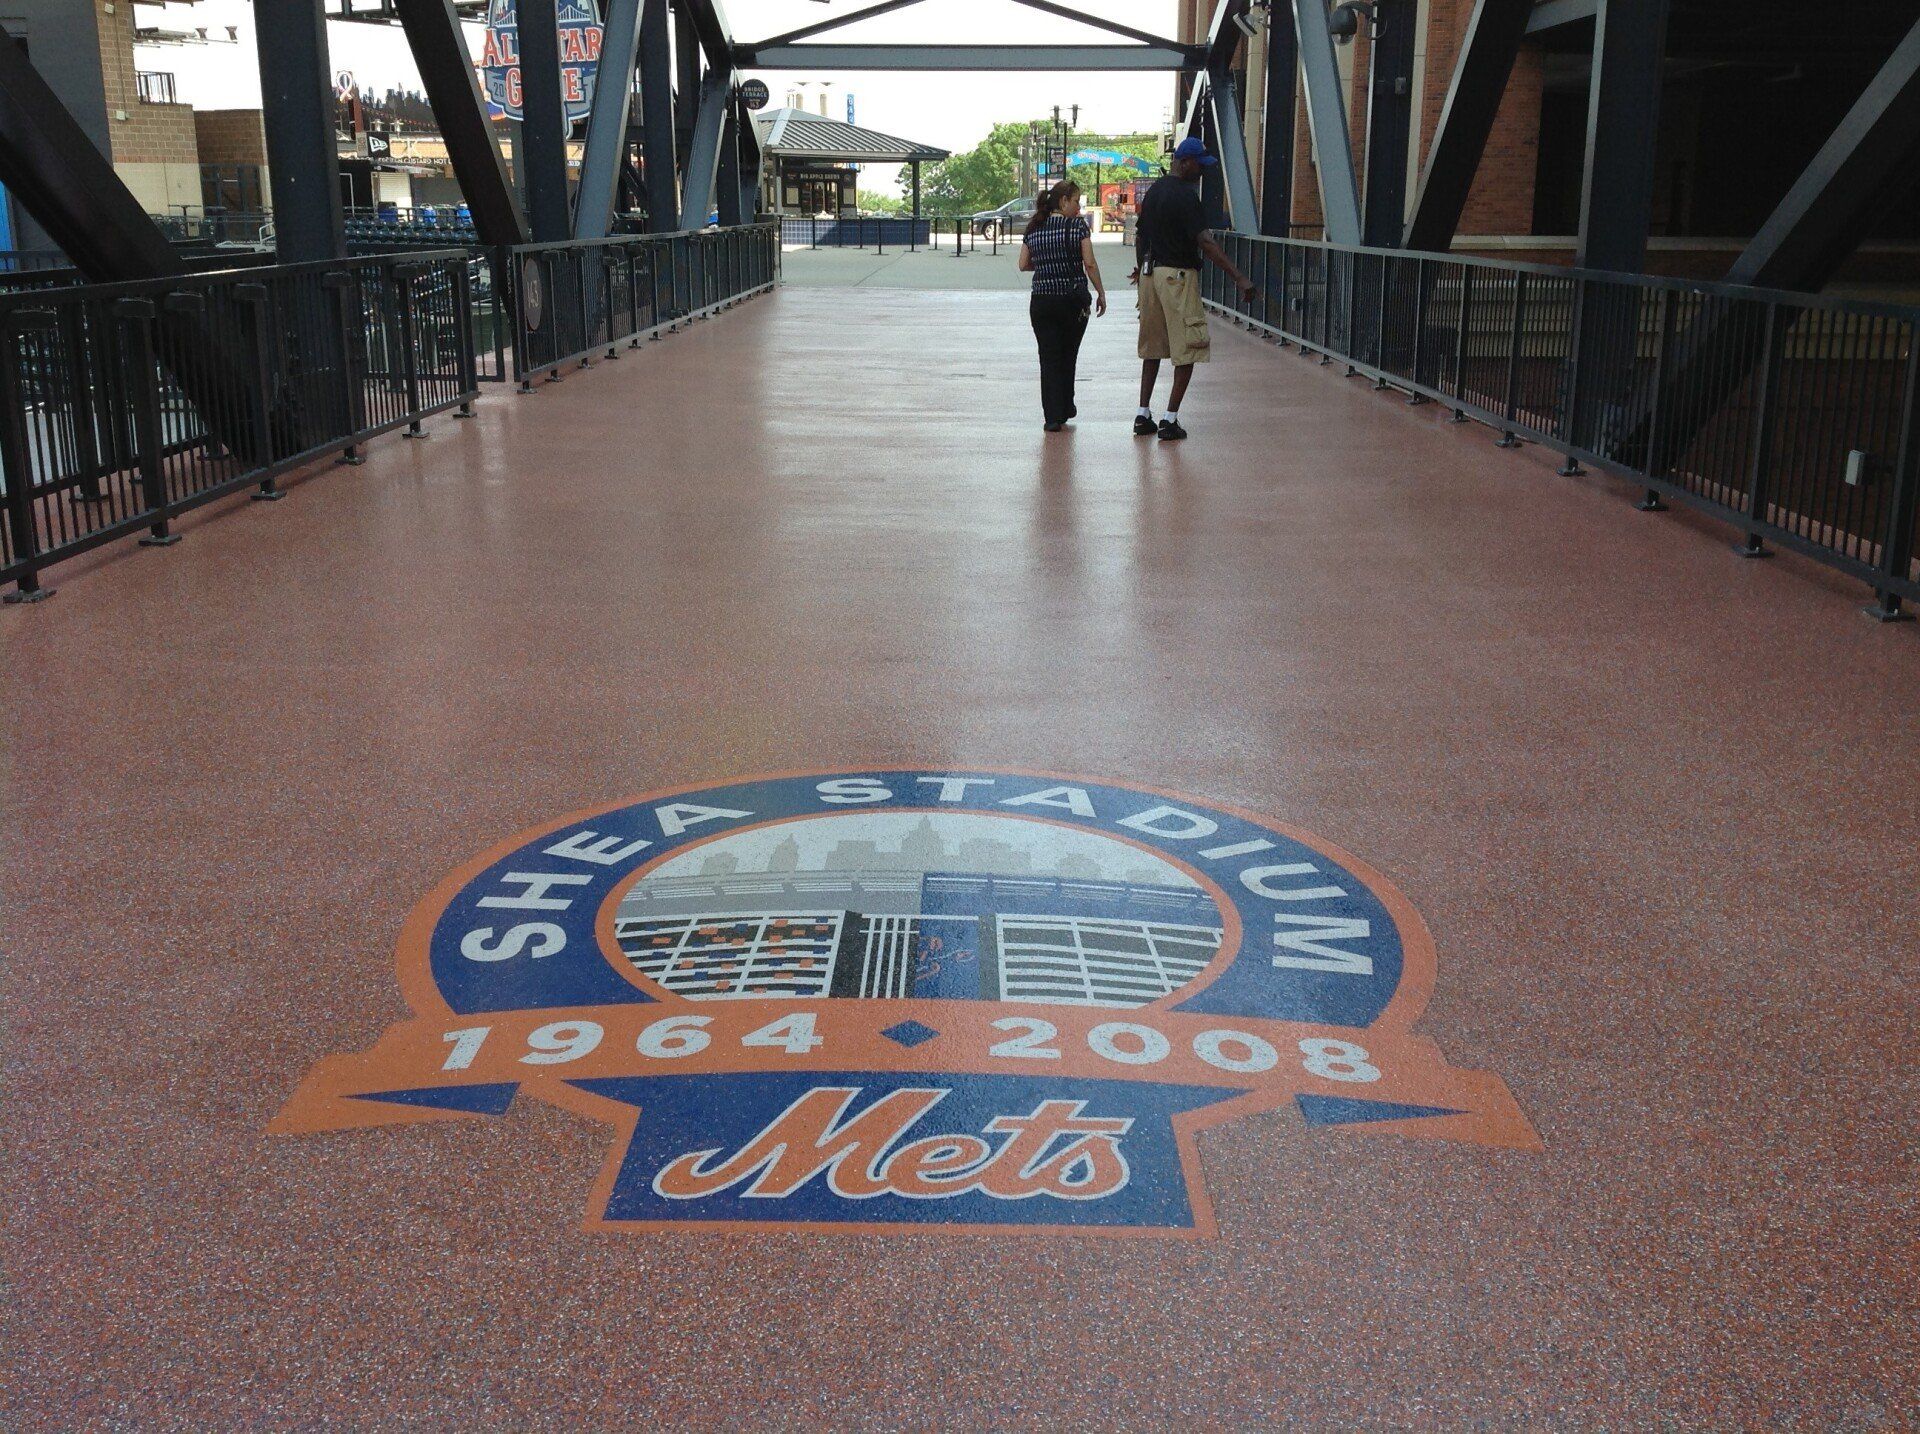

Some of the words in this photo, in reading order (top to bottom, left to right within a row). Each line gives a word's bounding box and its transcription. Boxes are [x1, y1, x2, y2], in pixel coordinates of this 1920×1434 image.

[459, 801, 756, 963] SHEA
[815, 775, 1374, 976] STADIUM
[441, 1012, 824, 1071] 1964
[988, 1016, 1382, 1083] 2008
[652, 1086, 1136, 1201] Mets
